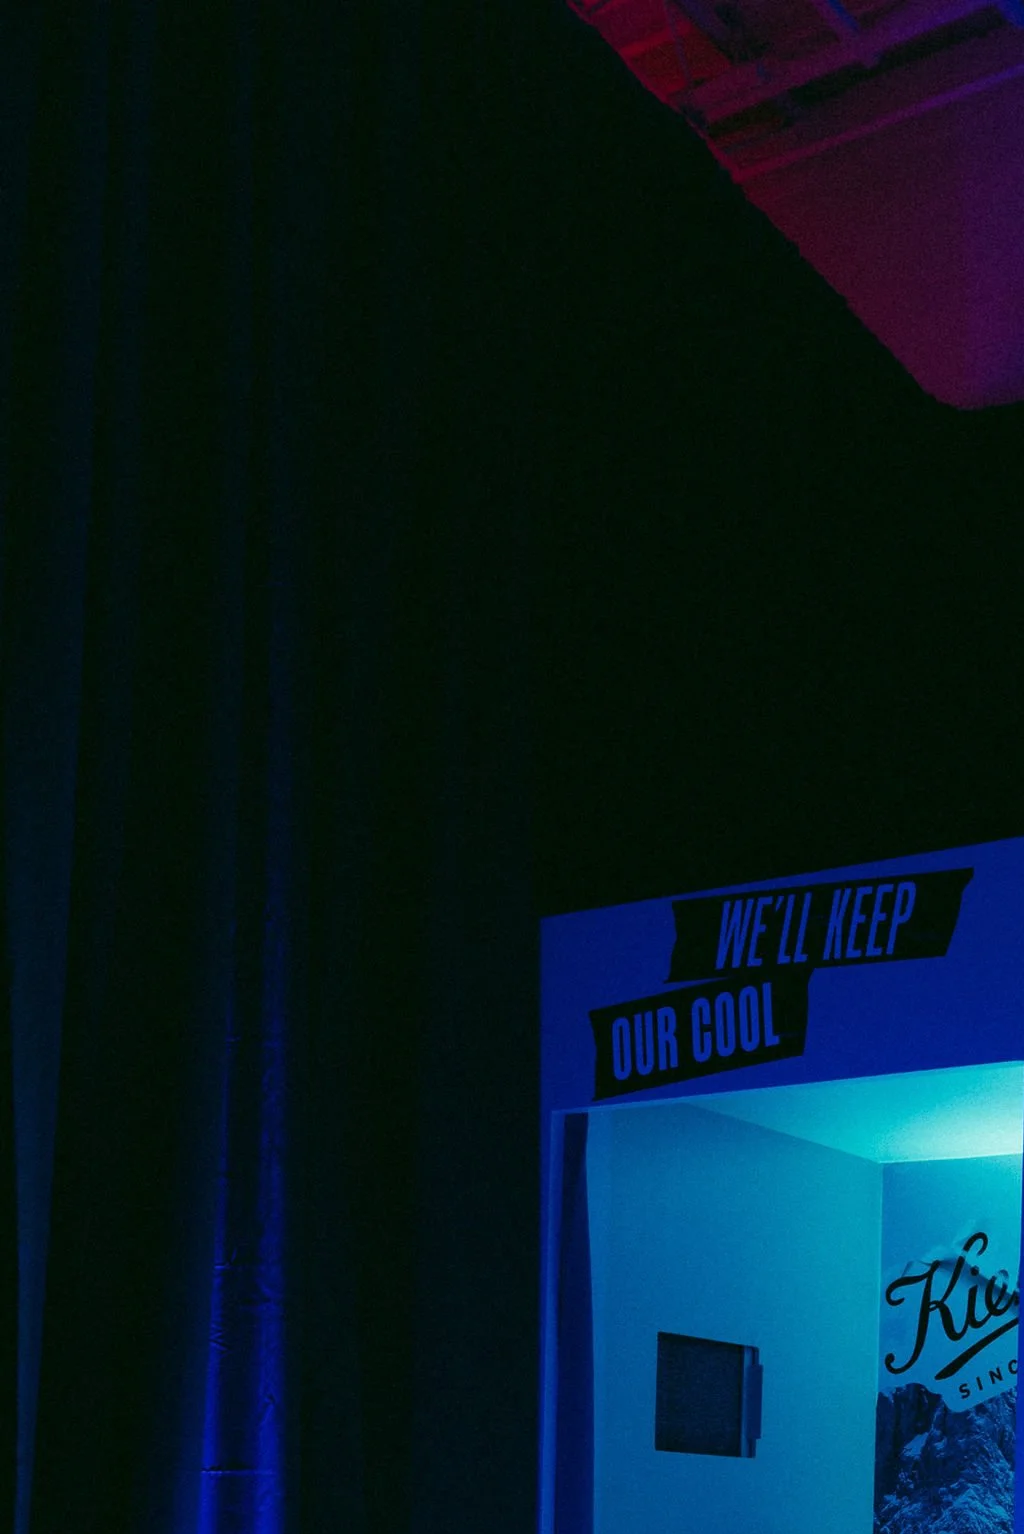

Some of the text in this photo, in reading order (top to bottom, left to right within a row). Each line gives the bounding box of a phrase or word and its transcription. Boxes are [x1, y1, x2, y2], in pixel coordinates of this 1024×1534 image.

[715, 880, 917, 970] WE'LL KEEP
[612, 982, 780, 1081] OUR COOL
[885, 1231, 1019, 1375] Kie
